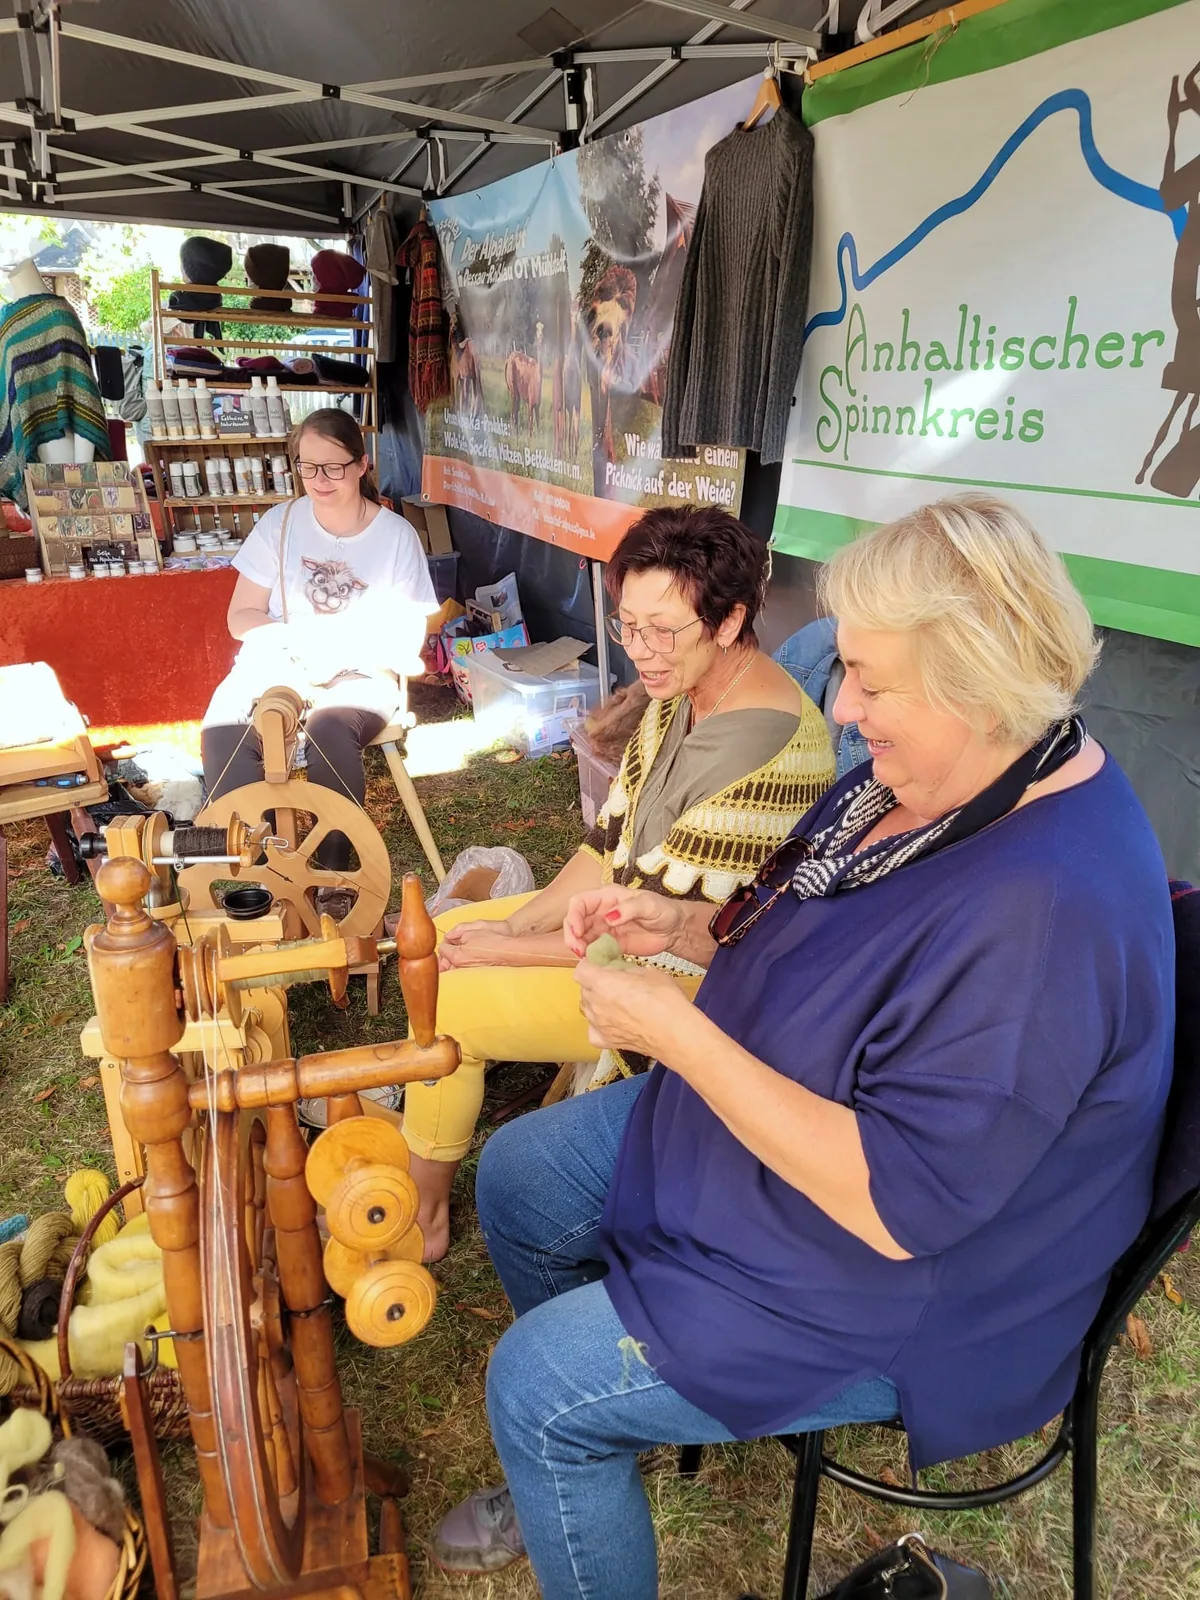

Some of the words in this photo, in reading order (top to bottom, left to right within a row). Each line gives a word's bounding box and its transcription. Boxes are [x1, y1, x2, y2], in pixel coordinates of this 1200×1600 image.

[460, 237, 480, 262] Der
[514, 259, 528, 279] OT
[845, 295, 1165, 397] Anhaltischer
[816, 365, 1044, 461] Spinnkreis
[624, 433, 646, 457] Wie
[704, 445, 739, 469] einem
[605, 462, 642, 491] Picknick
[644, 470, 664, 496] auf
[668, 472, 693, 499] der
[695, 475, 737, 506] Weide?
